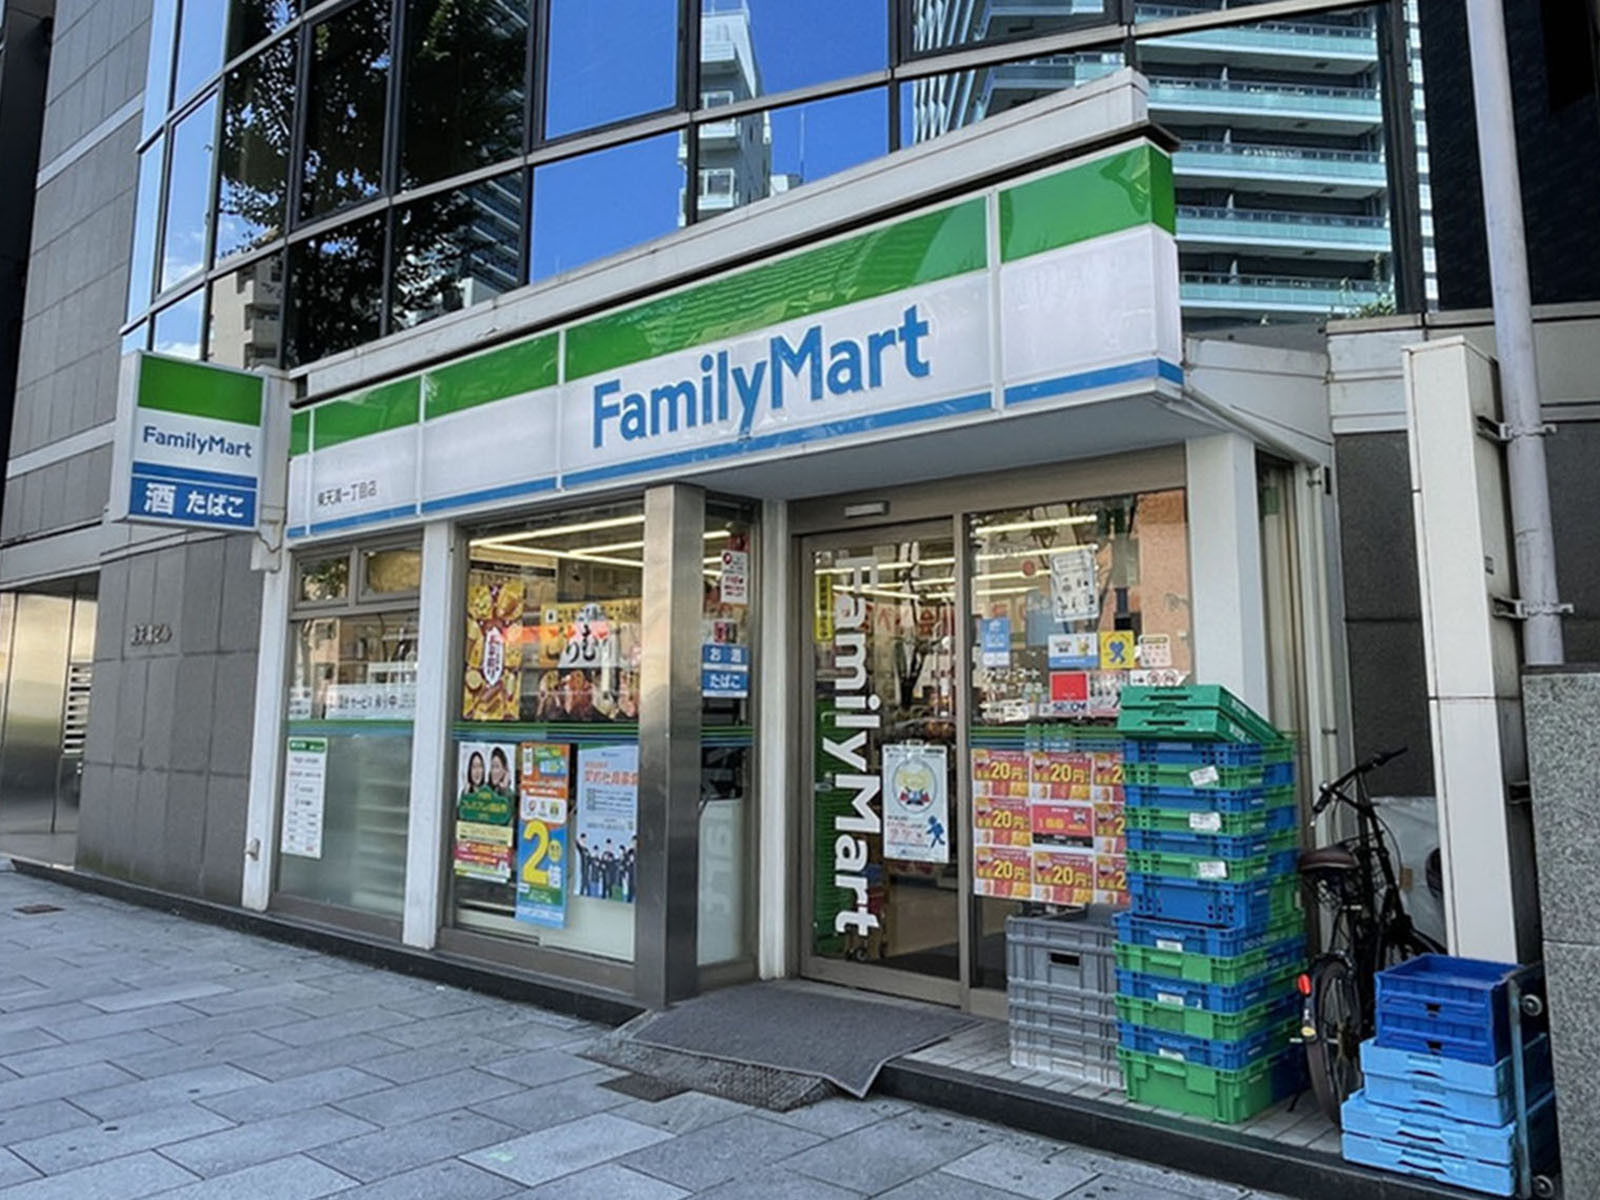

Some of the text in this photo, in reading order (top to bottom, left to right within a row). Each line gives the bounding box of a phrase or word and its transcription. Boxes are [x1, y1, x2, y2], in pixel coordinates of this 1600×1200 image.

[593, 304, 930, 448] FamilyMart
[142, 425, 253, 459] FamilyMart
[143, 482, 245, 519] 酒 たばこ
[709, 673, 742, 690] たばこ
[822, 555, 882, 937] FamilyMart
